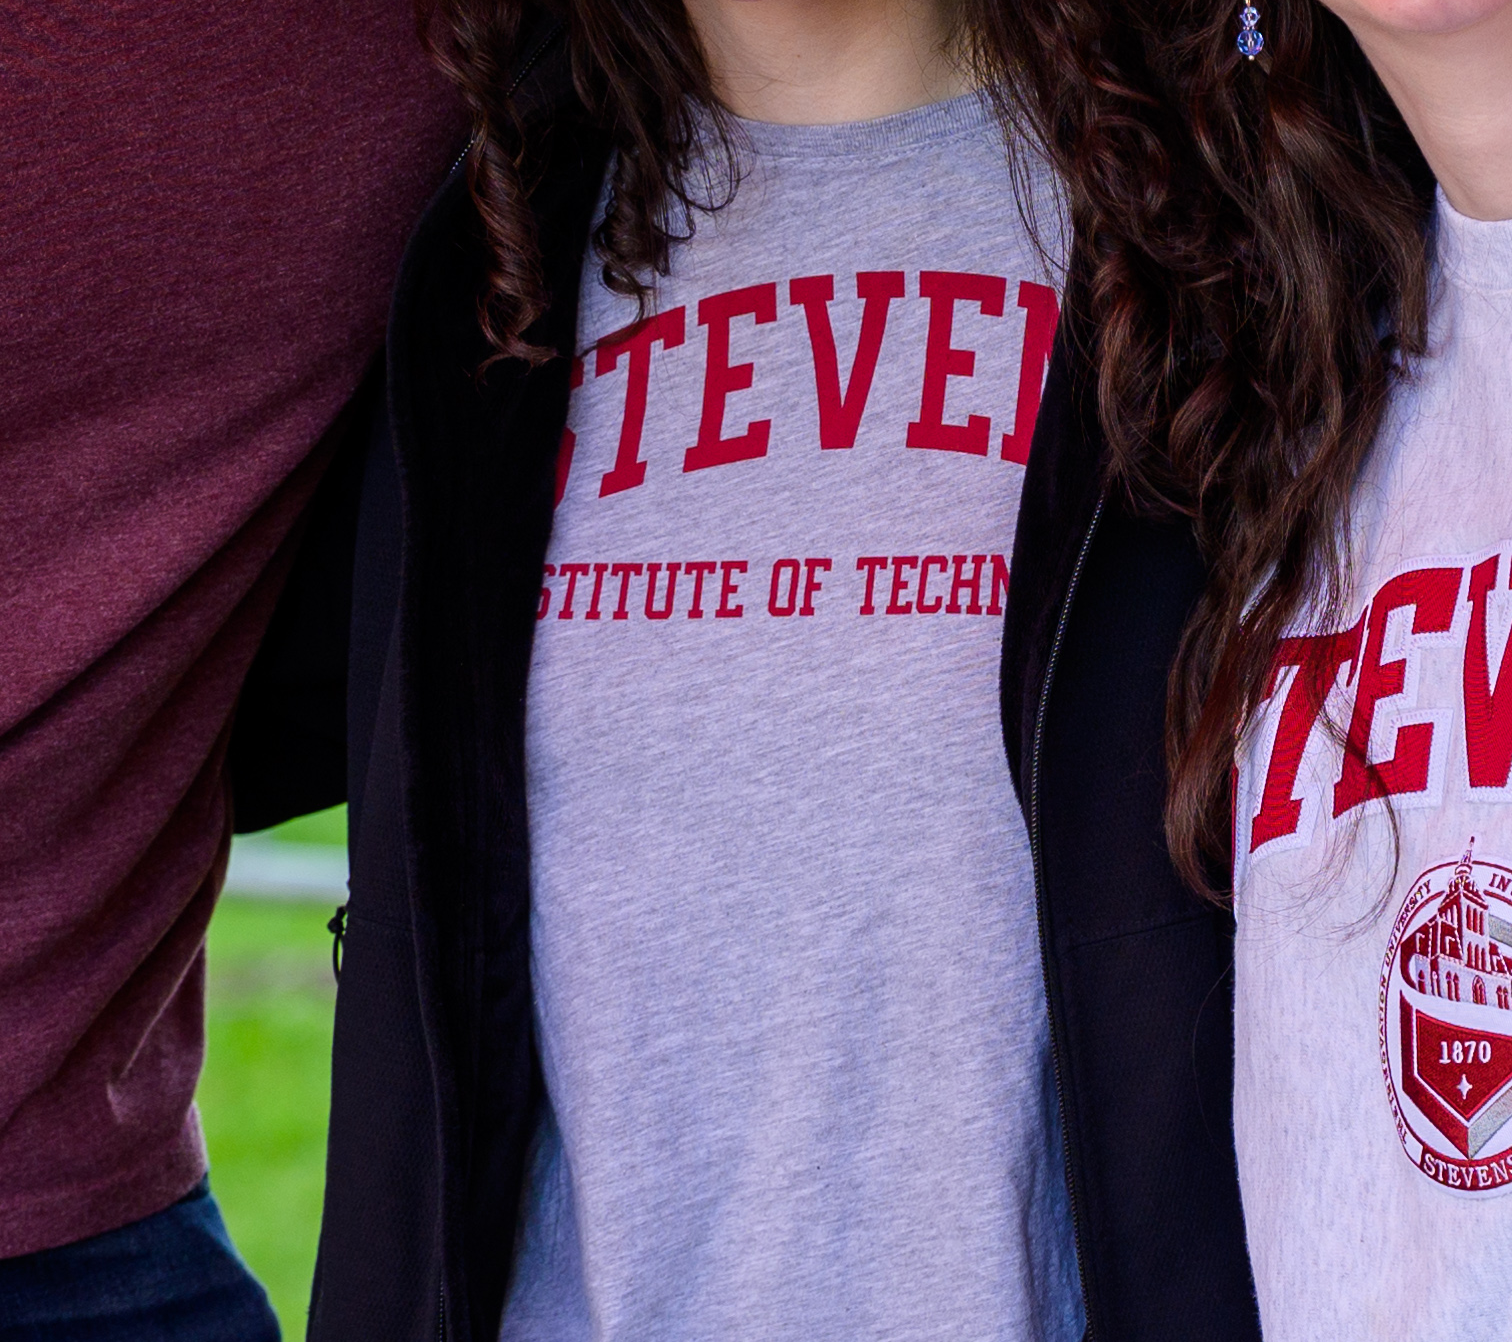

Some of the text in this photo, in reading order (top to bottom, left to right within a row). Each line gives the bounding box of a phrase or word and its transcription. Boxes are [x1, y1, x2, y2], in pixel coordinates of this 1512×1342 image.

[553, 270, 1059, 510] TEVE
[767, 557, 833, 617] OF
[1384, 879, 1433, 967] UNIVERSITY
[1438, 1040, 1493, 1065] 1870
